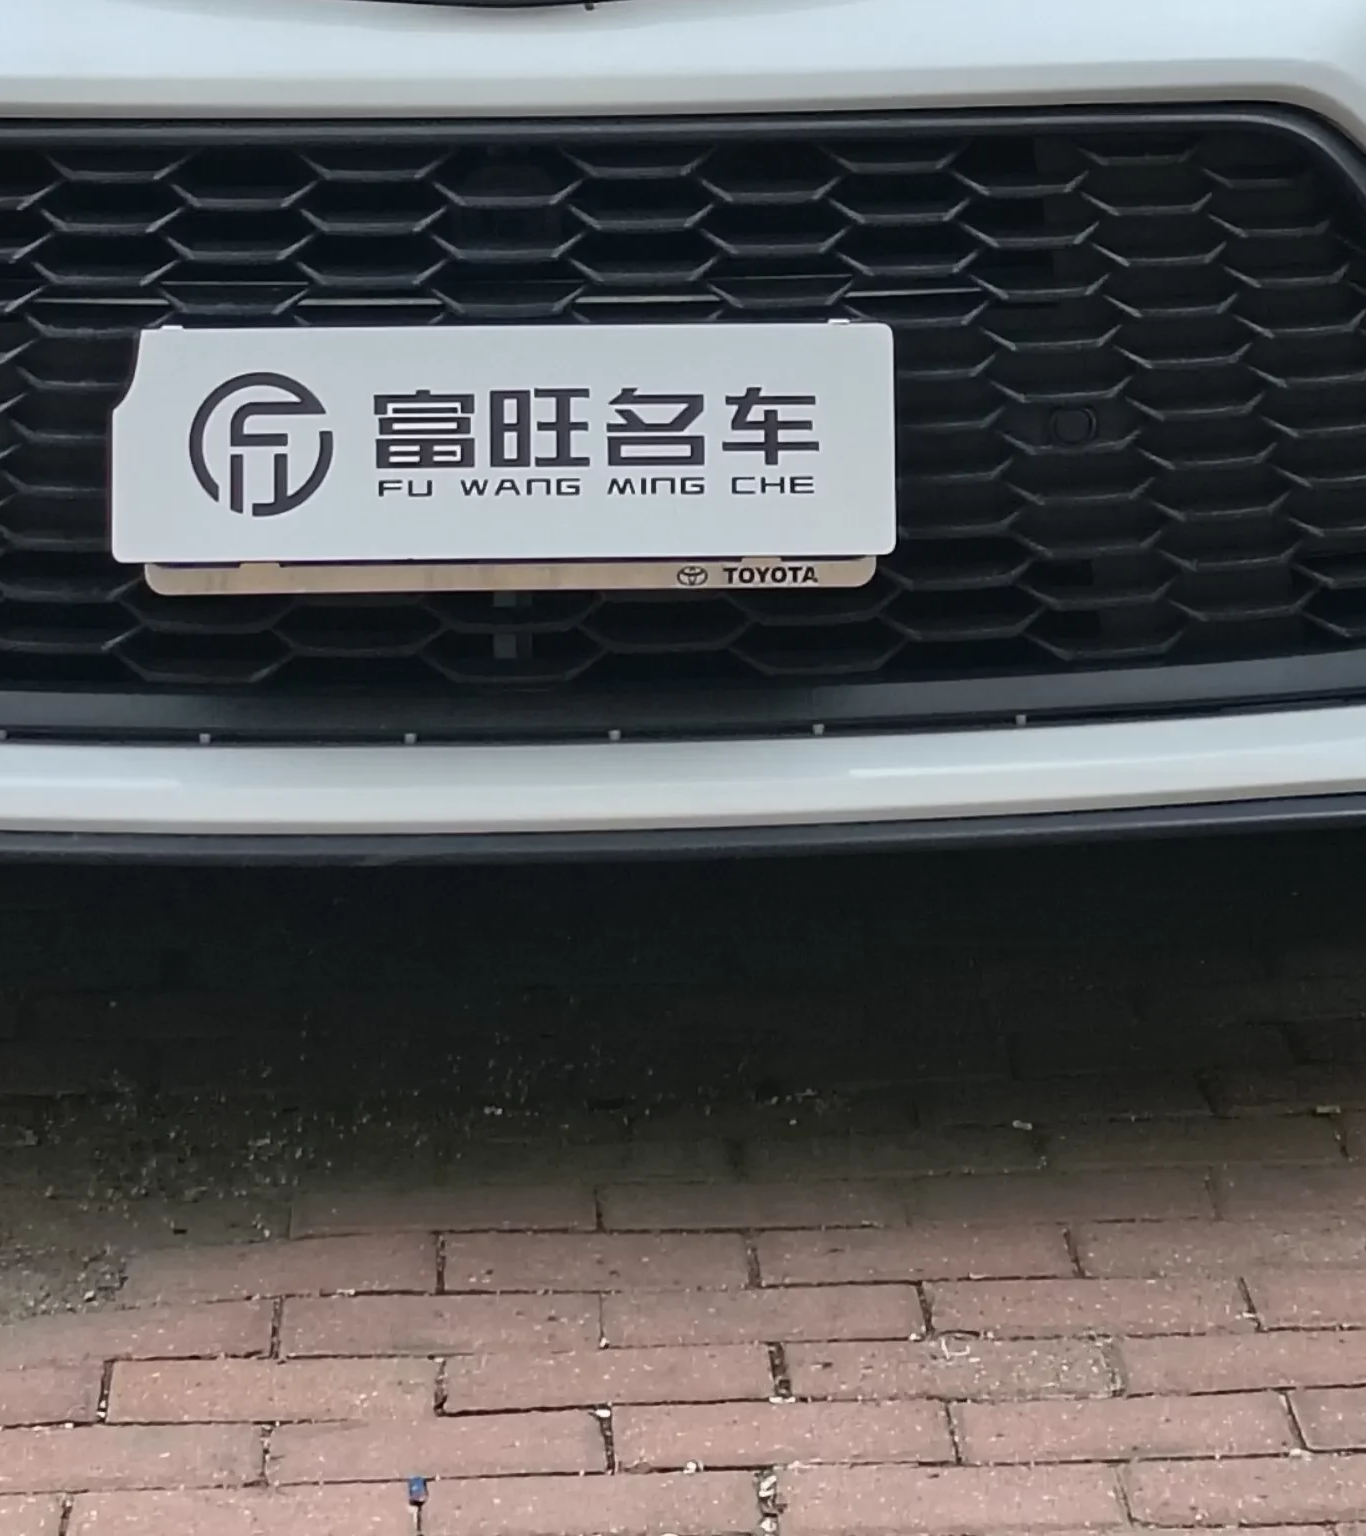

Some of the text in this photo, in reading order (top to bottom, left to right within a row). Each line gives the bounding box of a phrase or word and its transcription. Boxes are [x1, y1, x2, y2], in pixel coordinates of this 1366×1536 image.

[373, 386, 820, 469] 富旺名车
[378, 475, 815, 498] FU WANG MING CHE
[723, 566, 819, 585] TOYOTA
